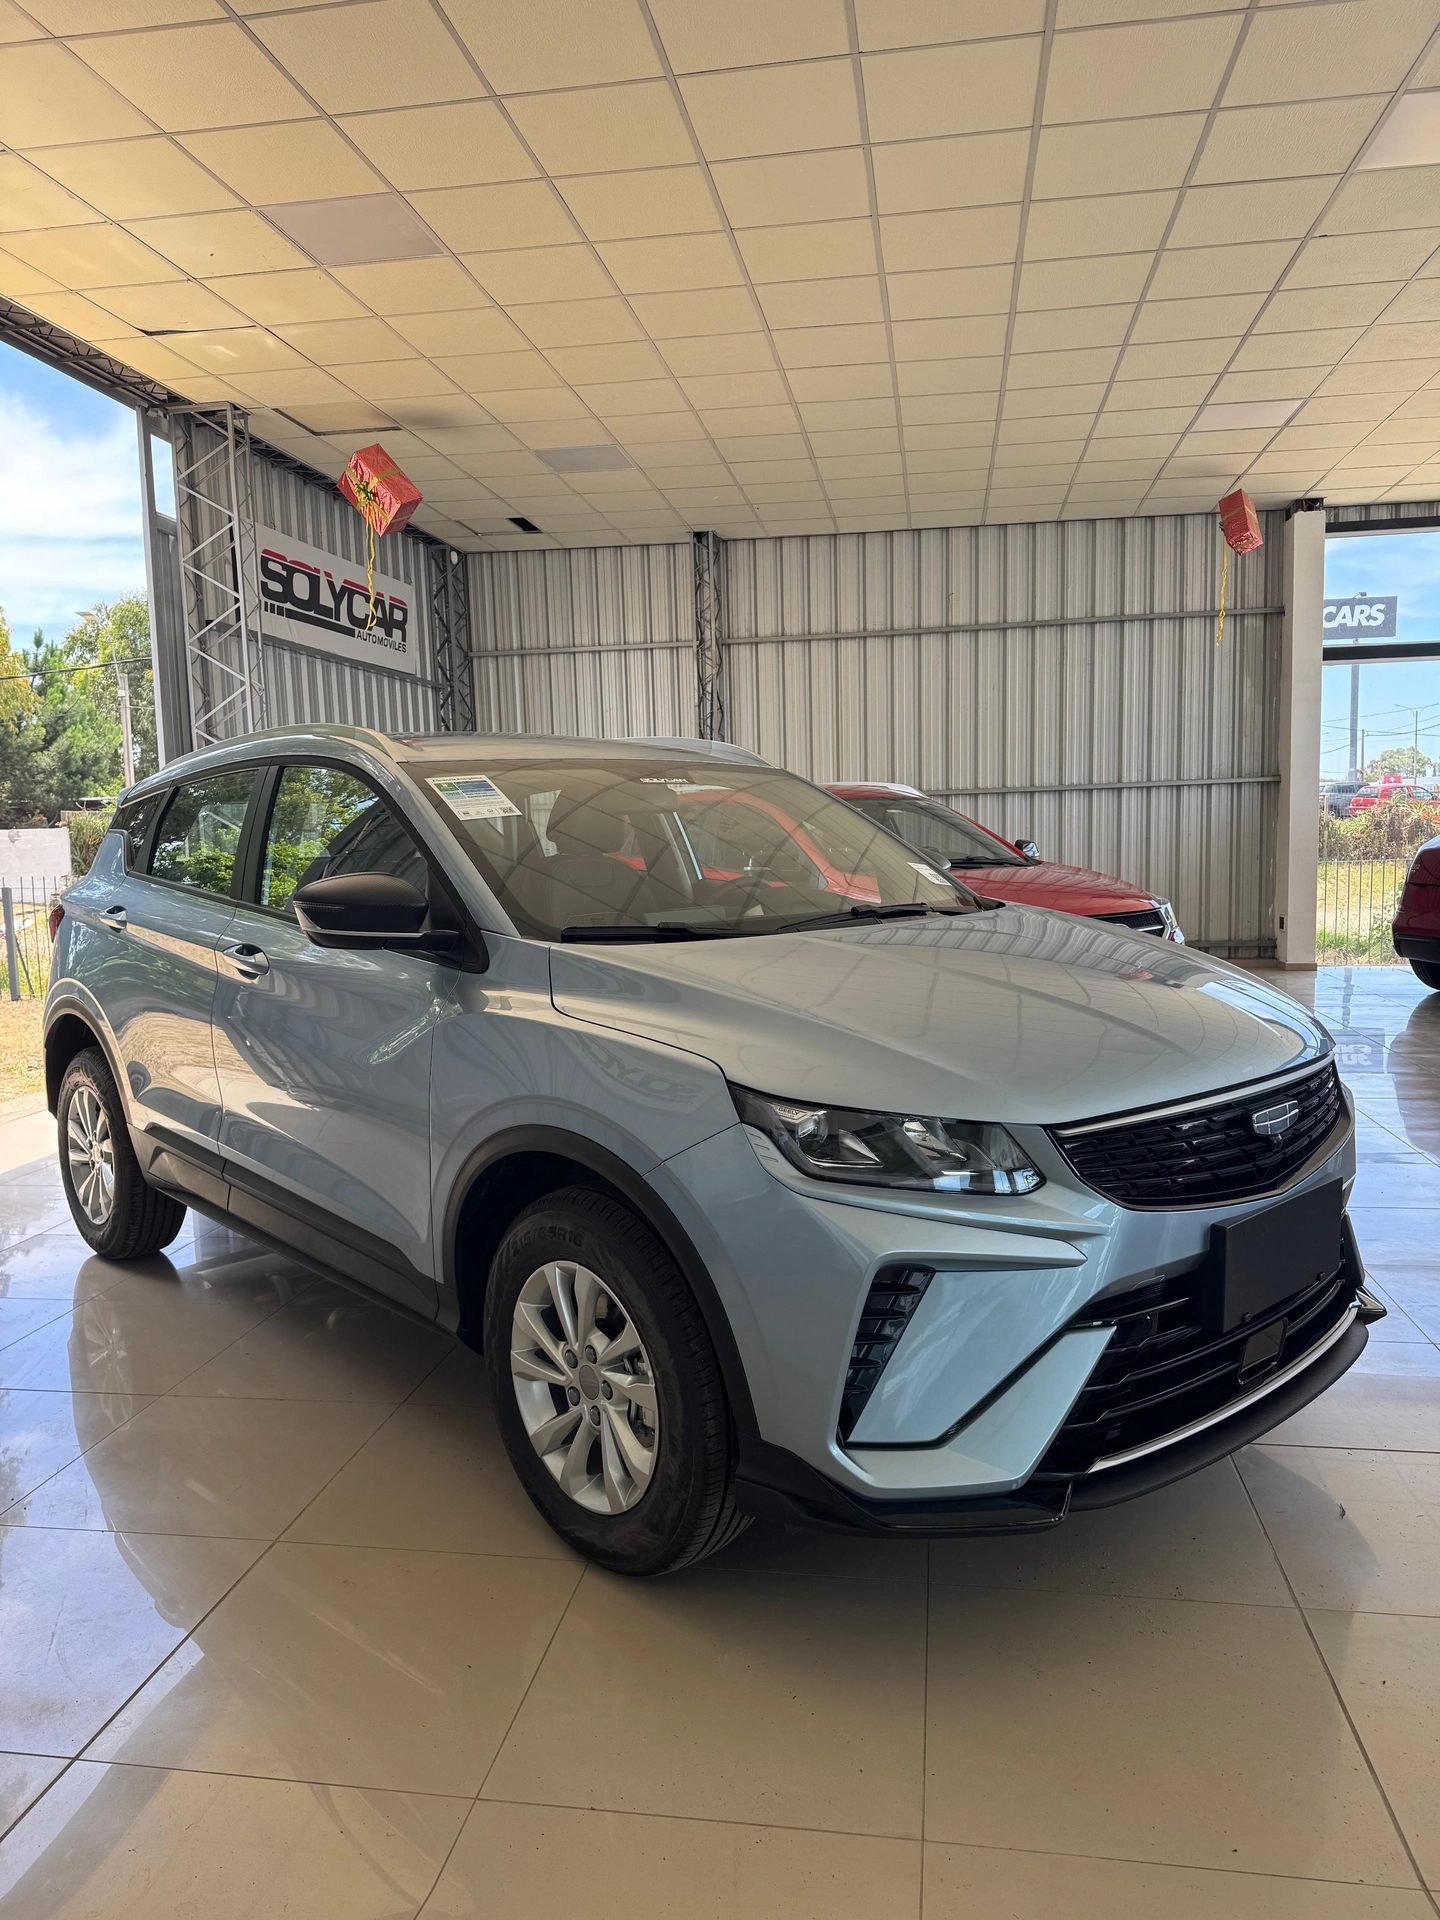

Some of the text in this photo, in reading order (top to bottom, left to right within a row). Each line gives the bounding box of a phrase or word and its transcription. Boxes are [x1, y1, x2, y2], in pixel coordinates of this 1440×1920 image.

[260, 548, 408, 642] SOLYCAR
[1323, 603, 1386, 628] CARS
[356, 631, 407, 653] AUTOMOVILES
[511, 1226, 583, 1257] 215/65R16
